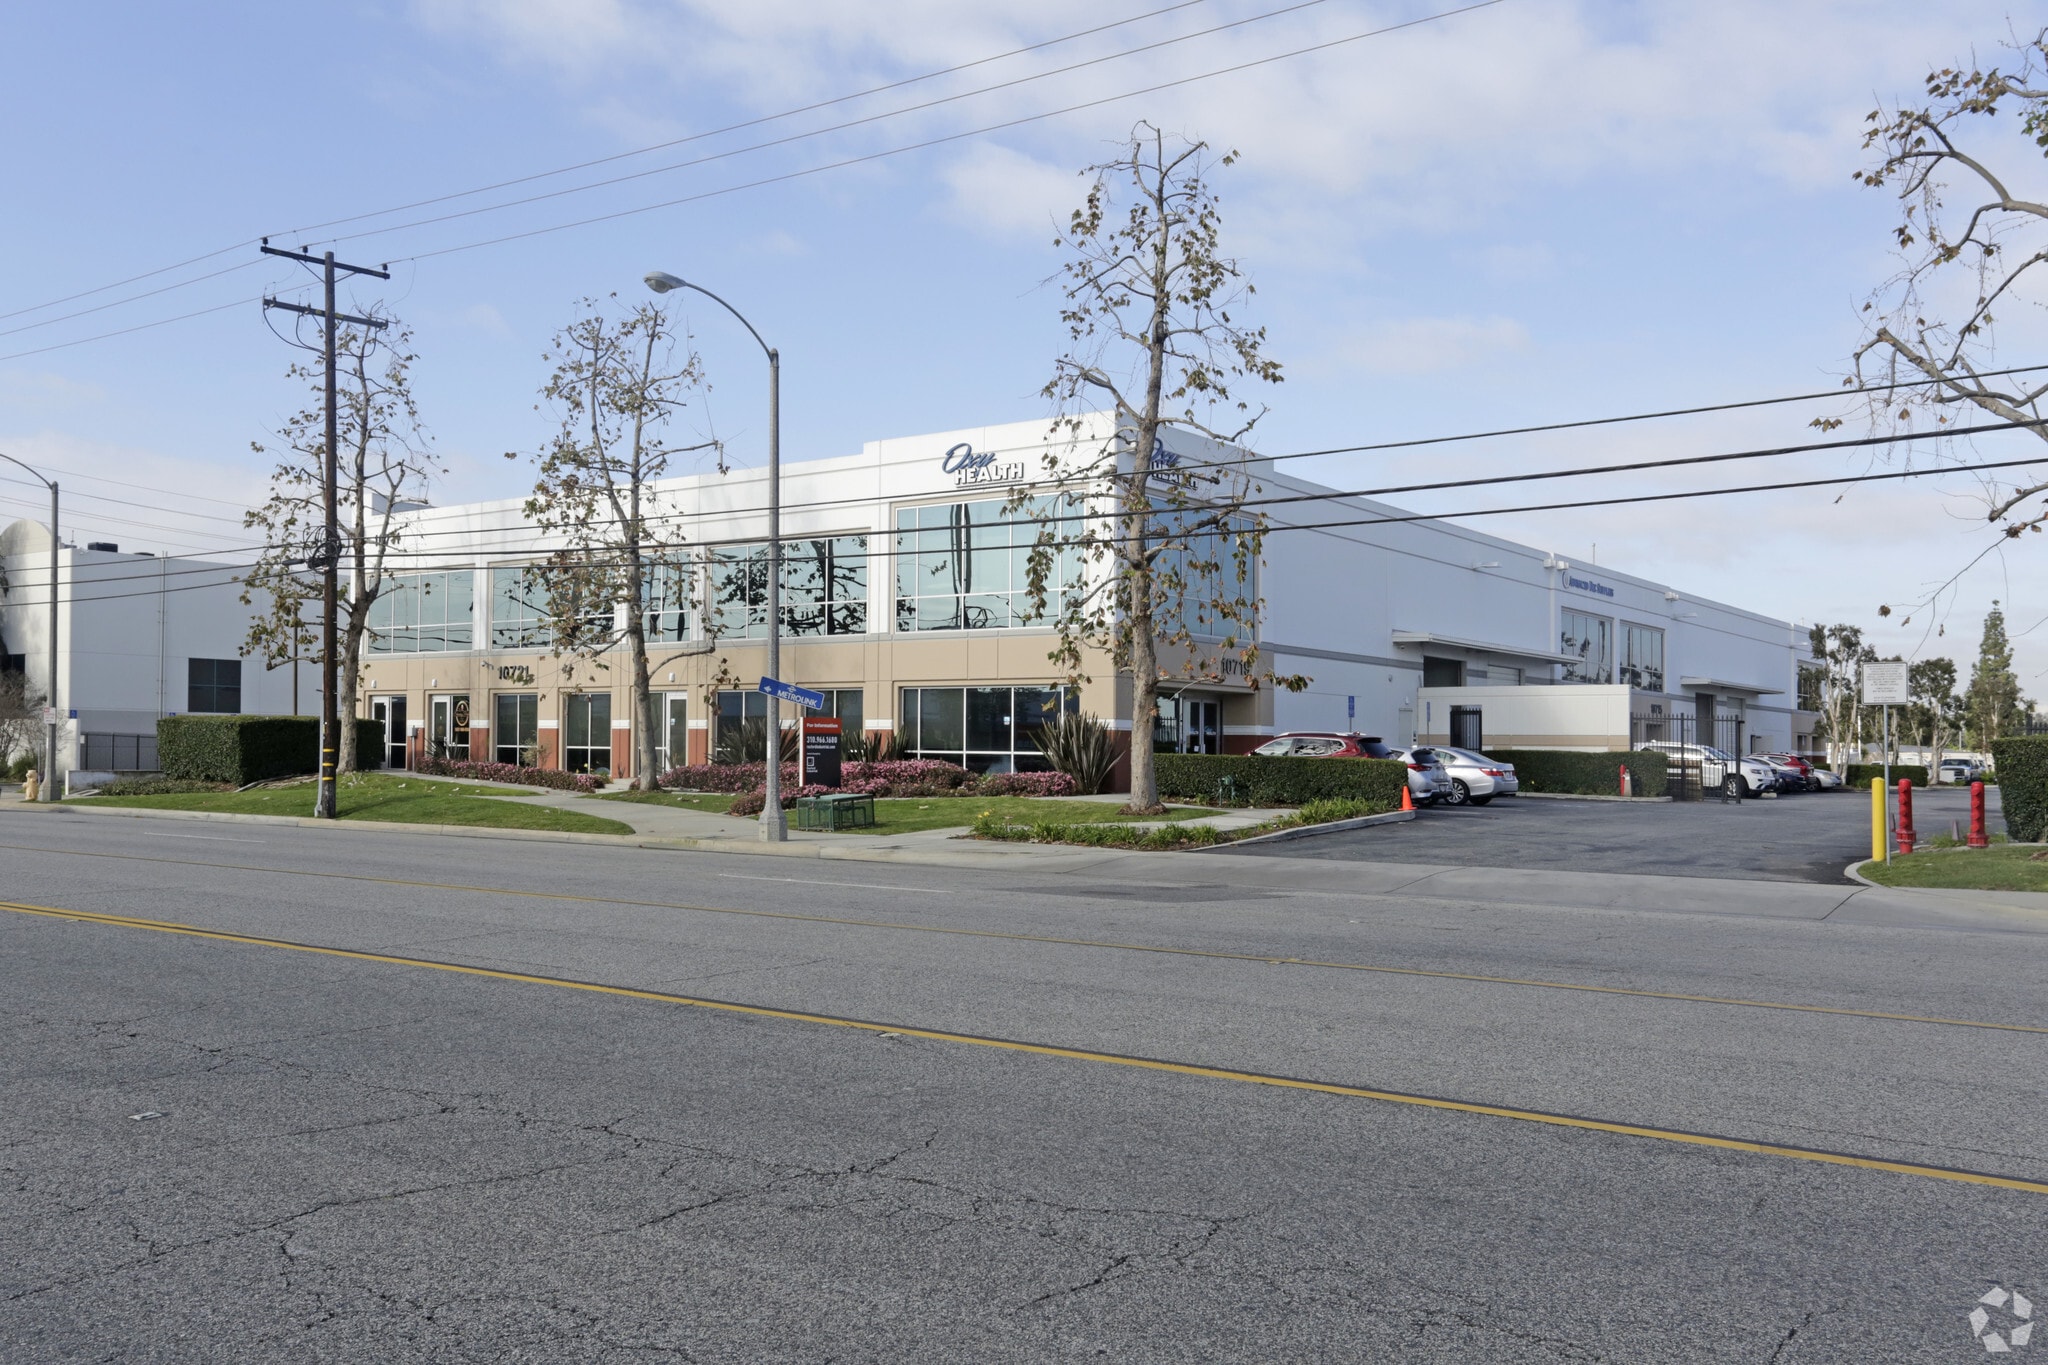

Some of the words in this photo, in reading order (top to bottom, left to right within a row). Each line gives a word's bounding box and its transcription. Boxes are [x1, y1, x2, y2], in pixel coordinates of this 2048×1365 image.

[941, 442, 997, 478] Oxy
[953, 462, 1024, 486] HEALTH
[777, 690, 817, 707] METROLINK
